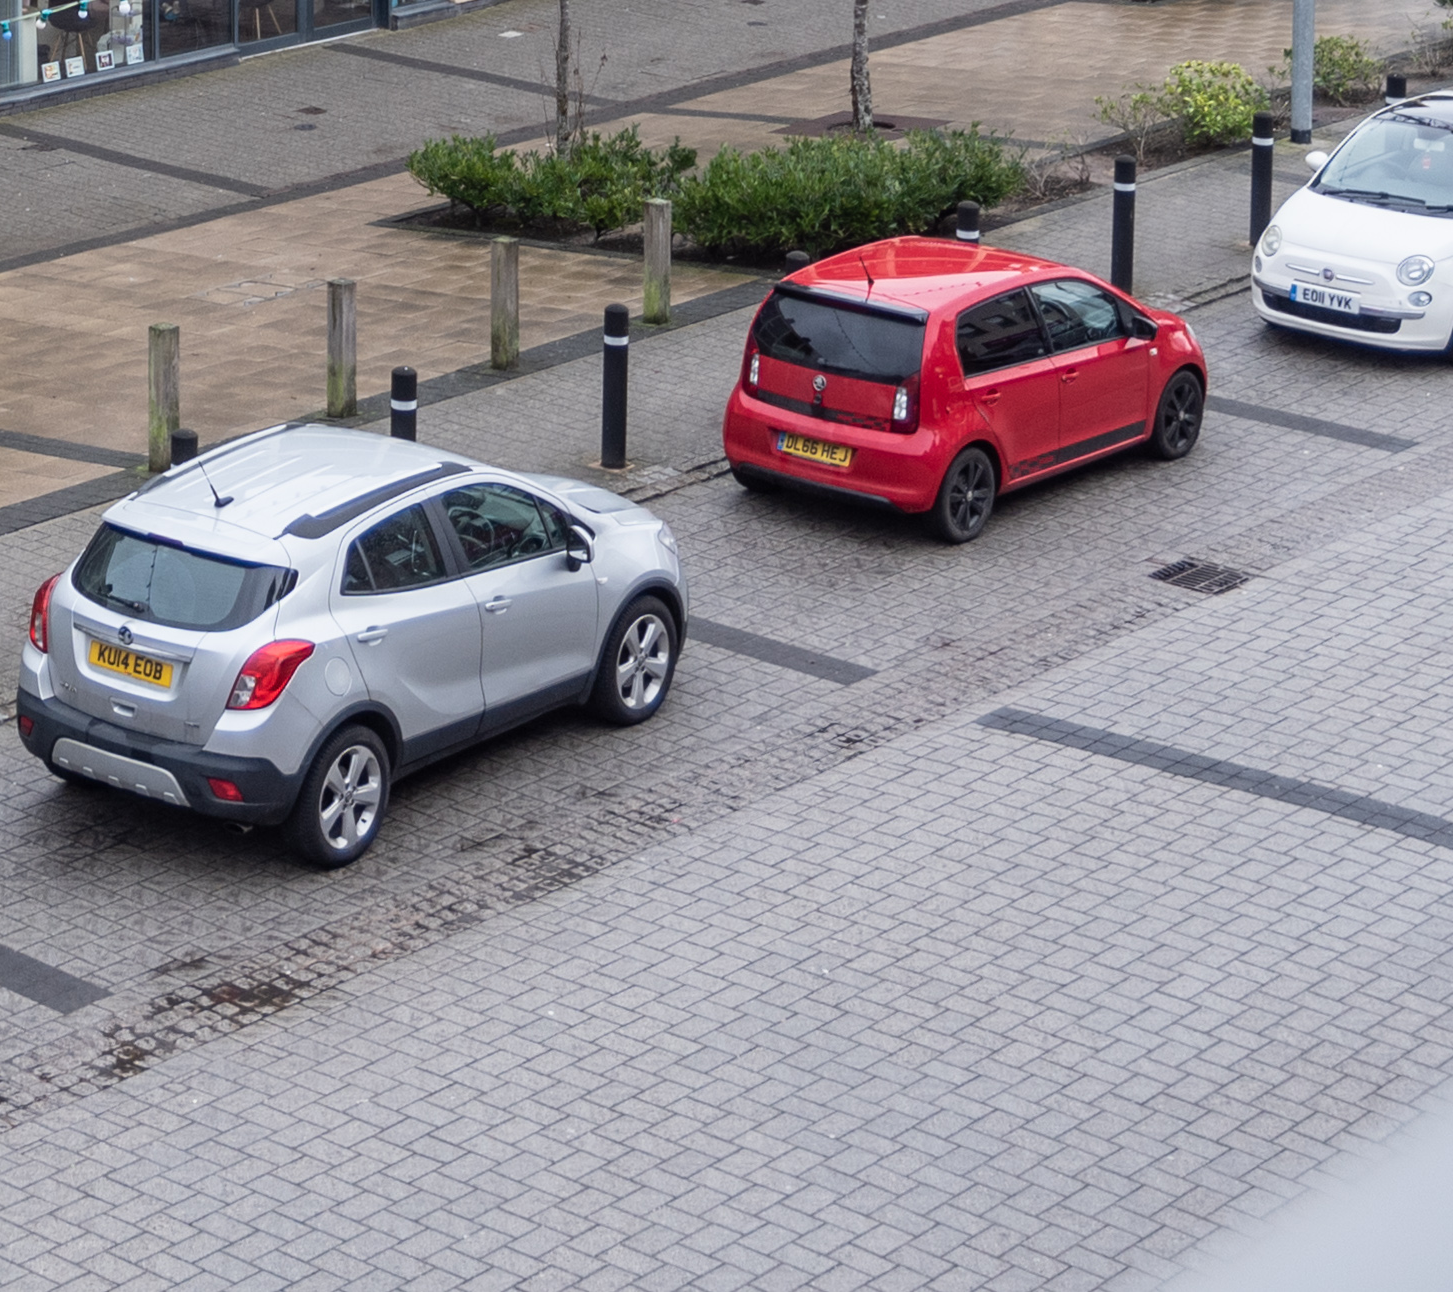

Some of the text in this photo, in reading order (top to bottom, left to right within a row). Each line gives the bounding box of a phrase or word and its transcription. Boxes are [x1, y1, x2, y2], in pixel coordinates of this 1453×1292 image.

[1328, 293, 1352, 310] YVK
[786, 435, 849, 462] DL66 HEJ
[97, 644, 163, 681] KU14 EOB
